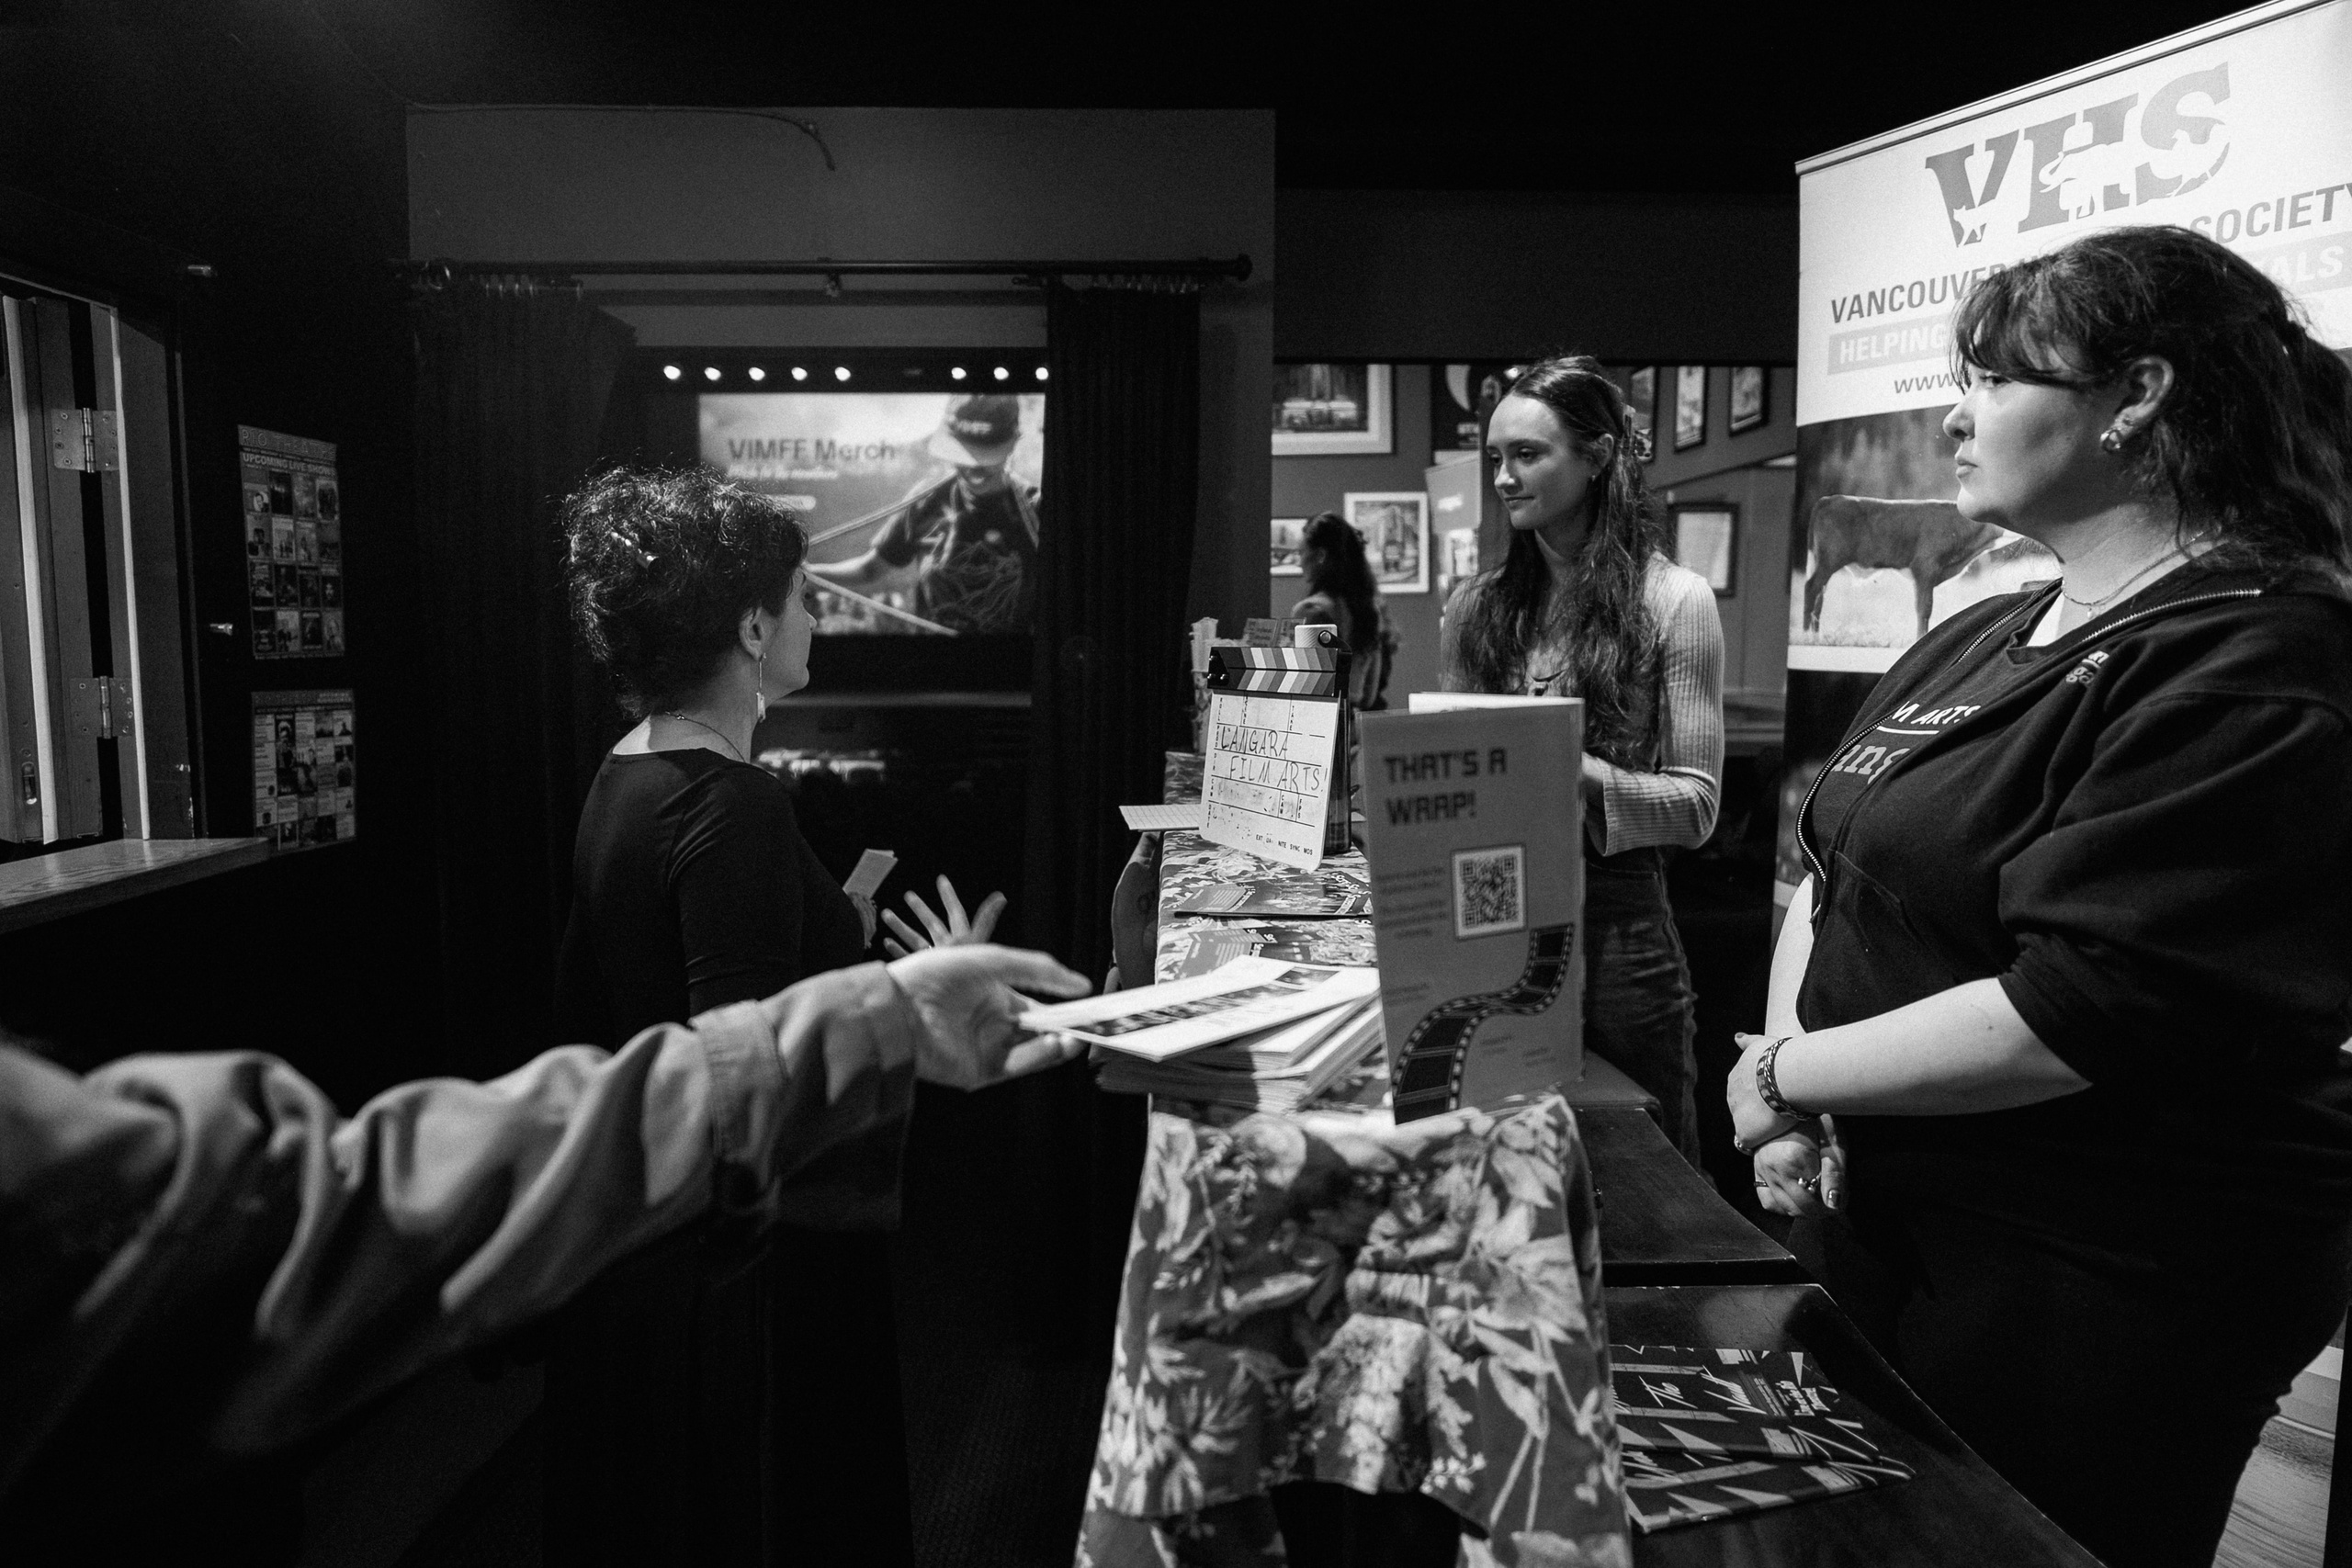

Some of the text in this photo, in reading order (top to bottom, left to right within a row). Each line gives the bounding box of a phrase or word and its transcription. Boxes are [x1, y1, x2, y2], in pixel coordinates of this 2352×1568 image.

[1925, 62, 2231, 248] VHS
[1840, 323, 1945, 364] HELPING
[1894, 373, 1955, 393] www
[241, 428, 267, 447] RIO
[729, 437, 895, 461] VIMFF Merch
[243, 453, 288, 469] UPCOMING
[288, 460, 308, 472] LIVE
[1220, 725, 1289, 760] LANGARA
[1229, 755, 1271, 784] FILM
[1384, 747, 1507, 783] THAT'S A
[1385, 789, 1476, 826] WRAP!
